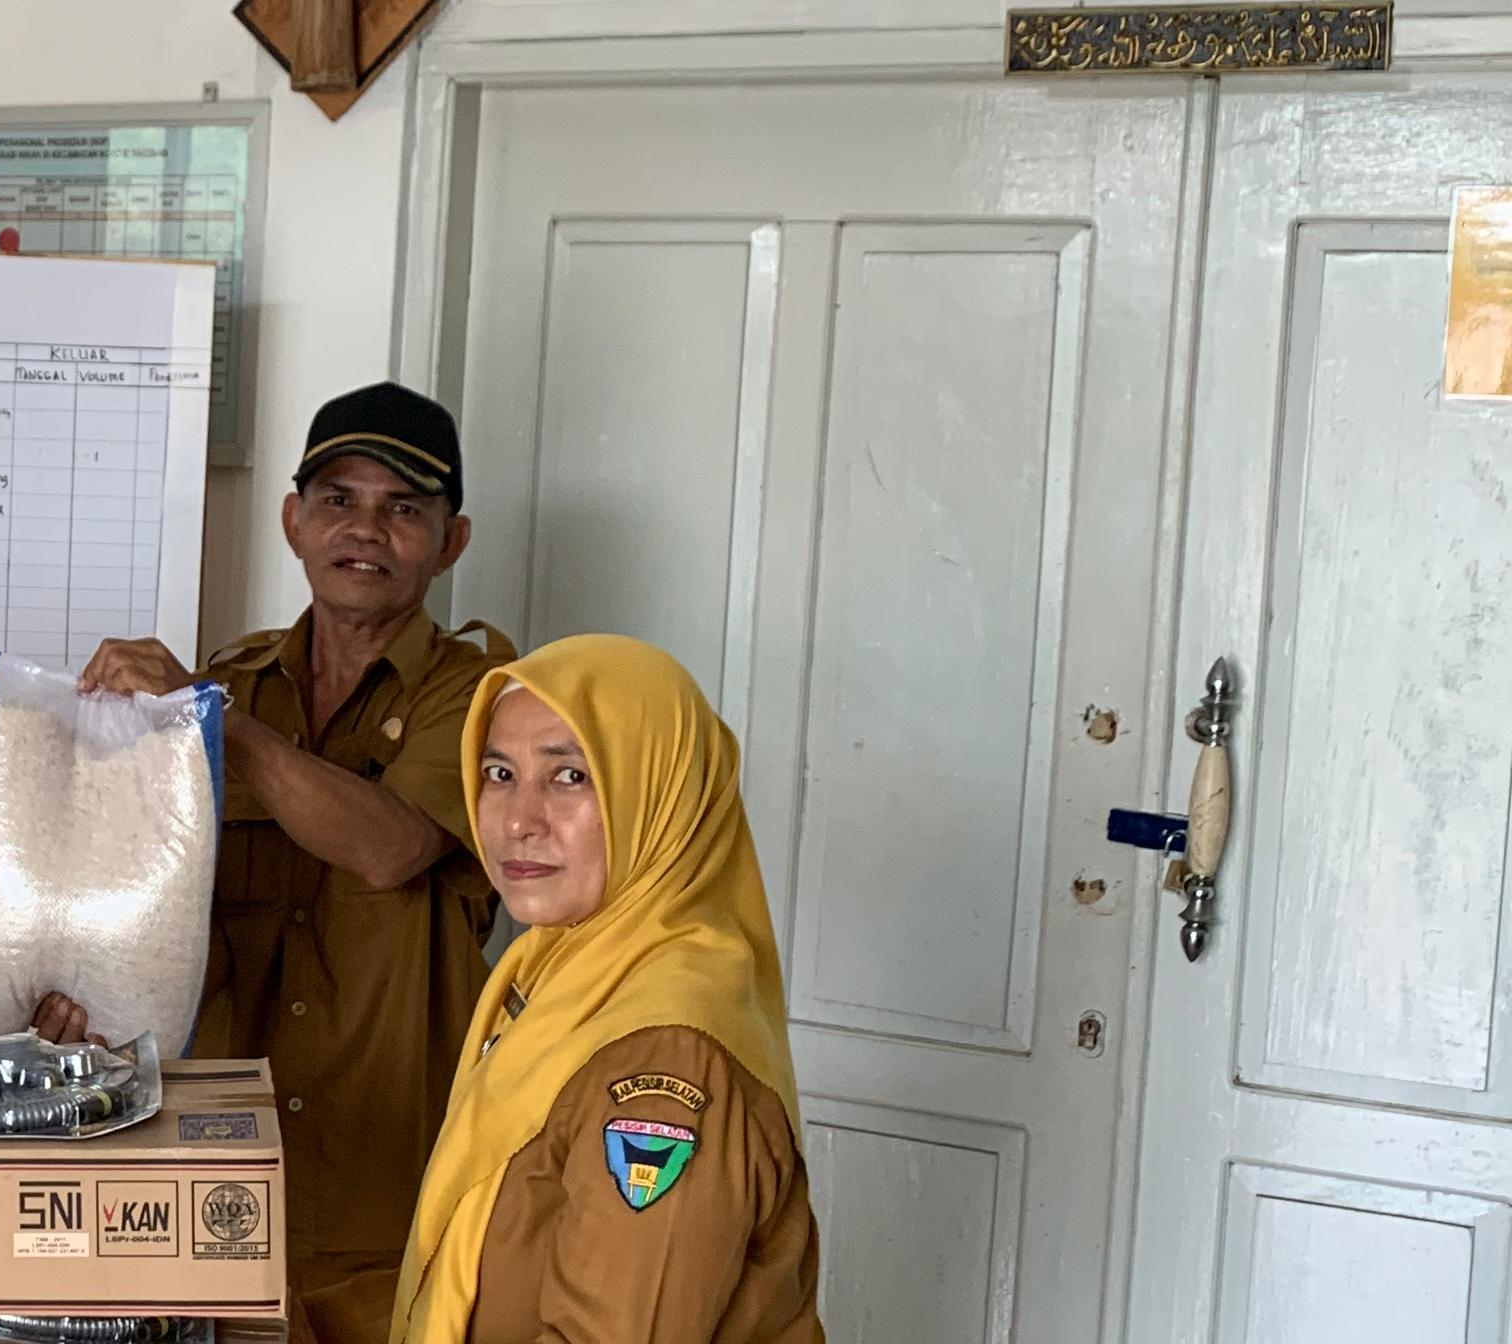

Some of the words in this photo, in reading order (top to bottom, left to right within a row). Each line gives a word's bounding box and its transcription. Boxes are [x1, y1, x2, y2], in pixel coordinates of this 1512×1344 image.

[50, 345, 110, 362] KELUAR
[16, 367, 67, 381] TANGGAL
[79, 370, 125, 382] VOLUME
[19, 1191, 83, 1230] SNI
[120, 1201, 170, 1232] KAN
[204, 1244, 218, 1252] ISO
